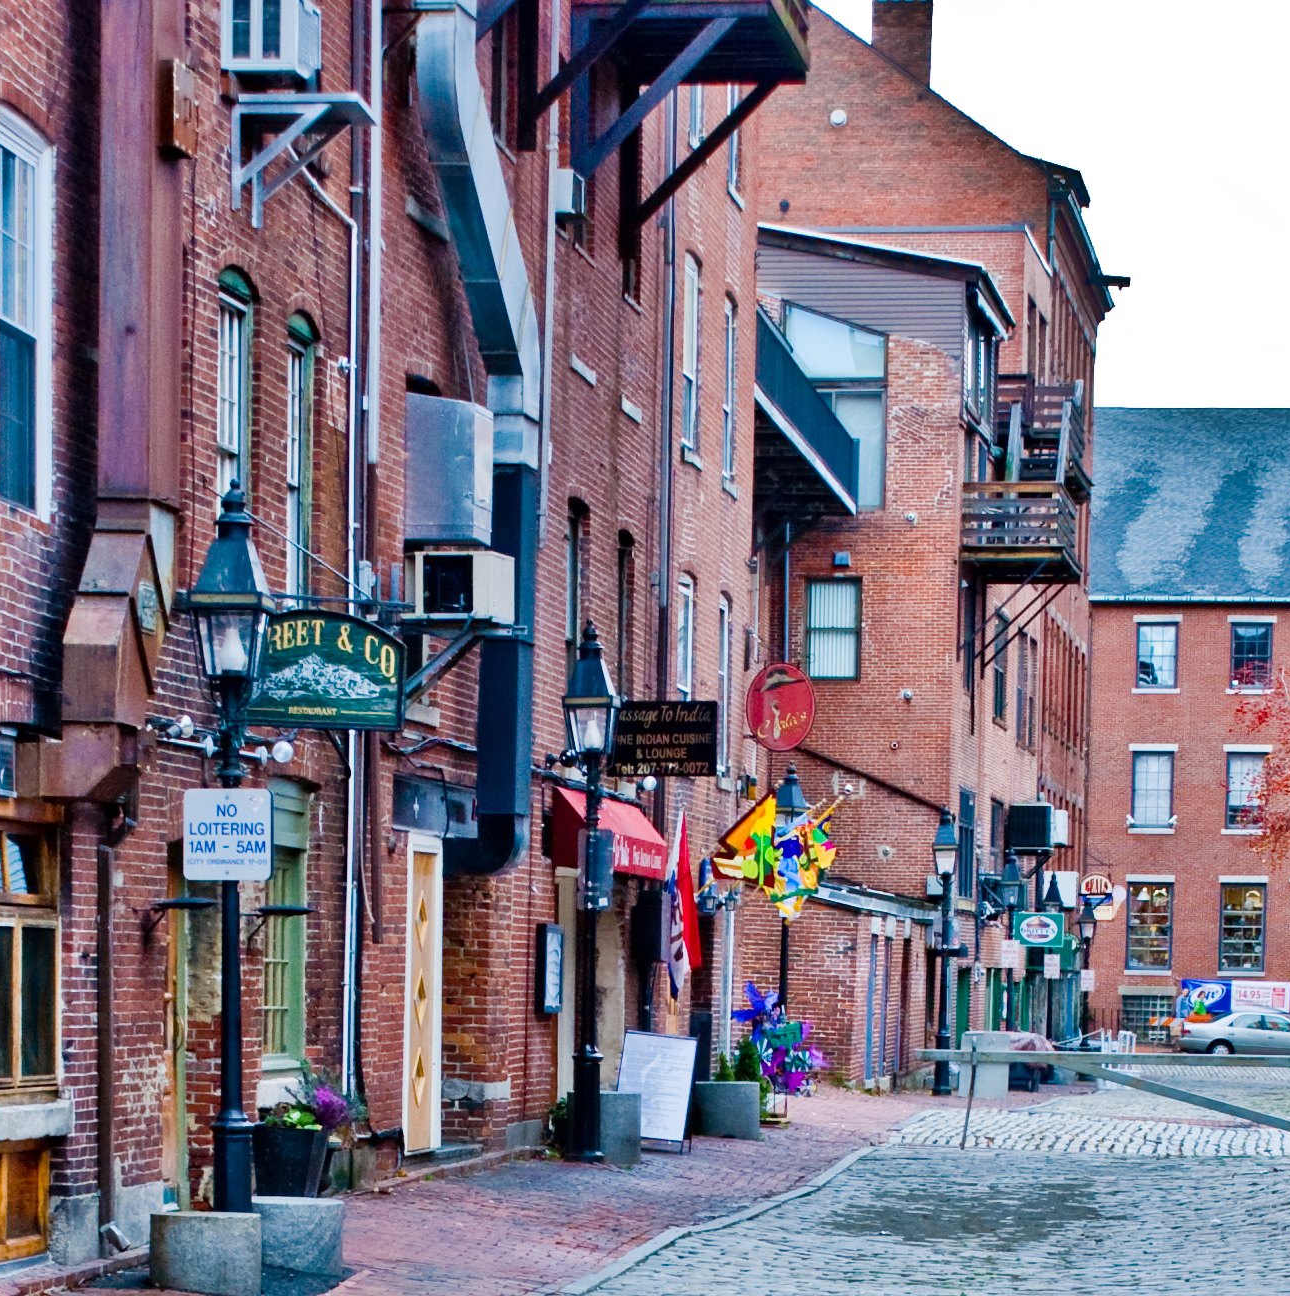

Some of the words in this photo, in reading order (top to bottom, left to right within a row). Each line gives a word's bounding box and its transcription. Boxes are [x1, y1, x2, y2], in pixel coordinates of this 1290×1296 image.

[267, 619, 326, 654] REET
[337, 624, 354, 654] &
[364, 634, 397, 684] CO.
[619, 708, 659, 729] assage
[660, 705, 673, 722] To
[675, 704, 711, 722] India
[636, 733, 670, 745] INDIAN
[672, 733, 712, 745] CUISINE
[645, 747, 688, 759] LOUNGE
[216, 803, 238, 817] NO
[189, 822, 265, 836] LOITERING
[189, 840, 216, 854] 1AM
[236, 840, 266, 854] 5AM
